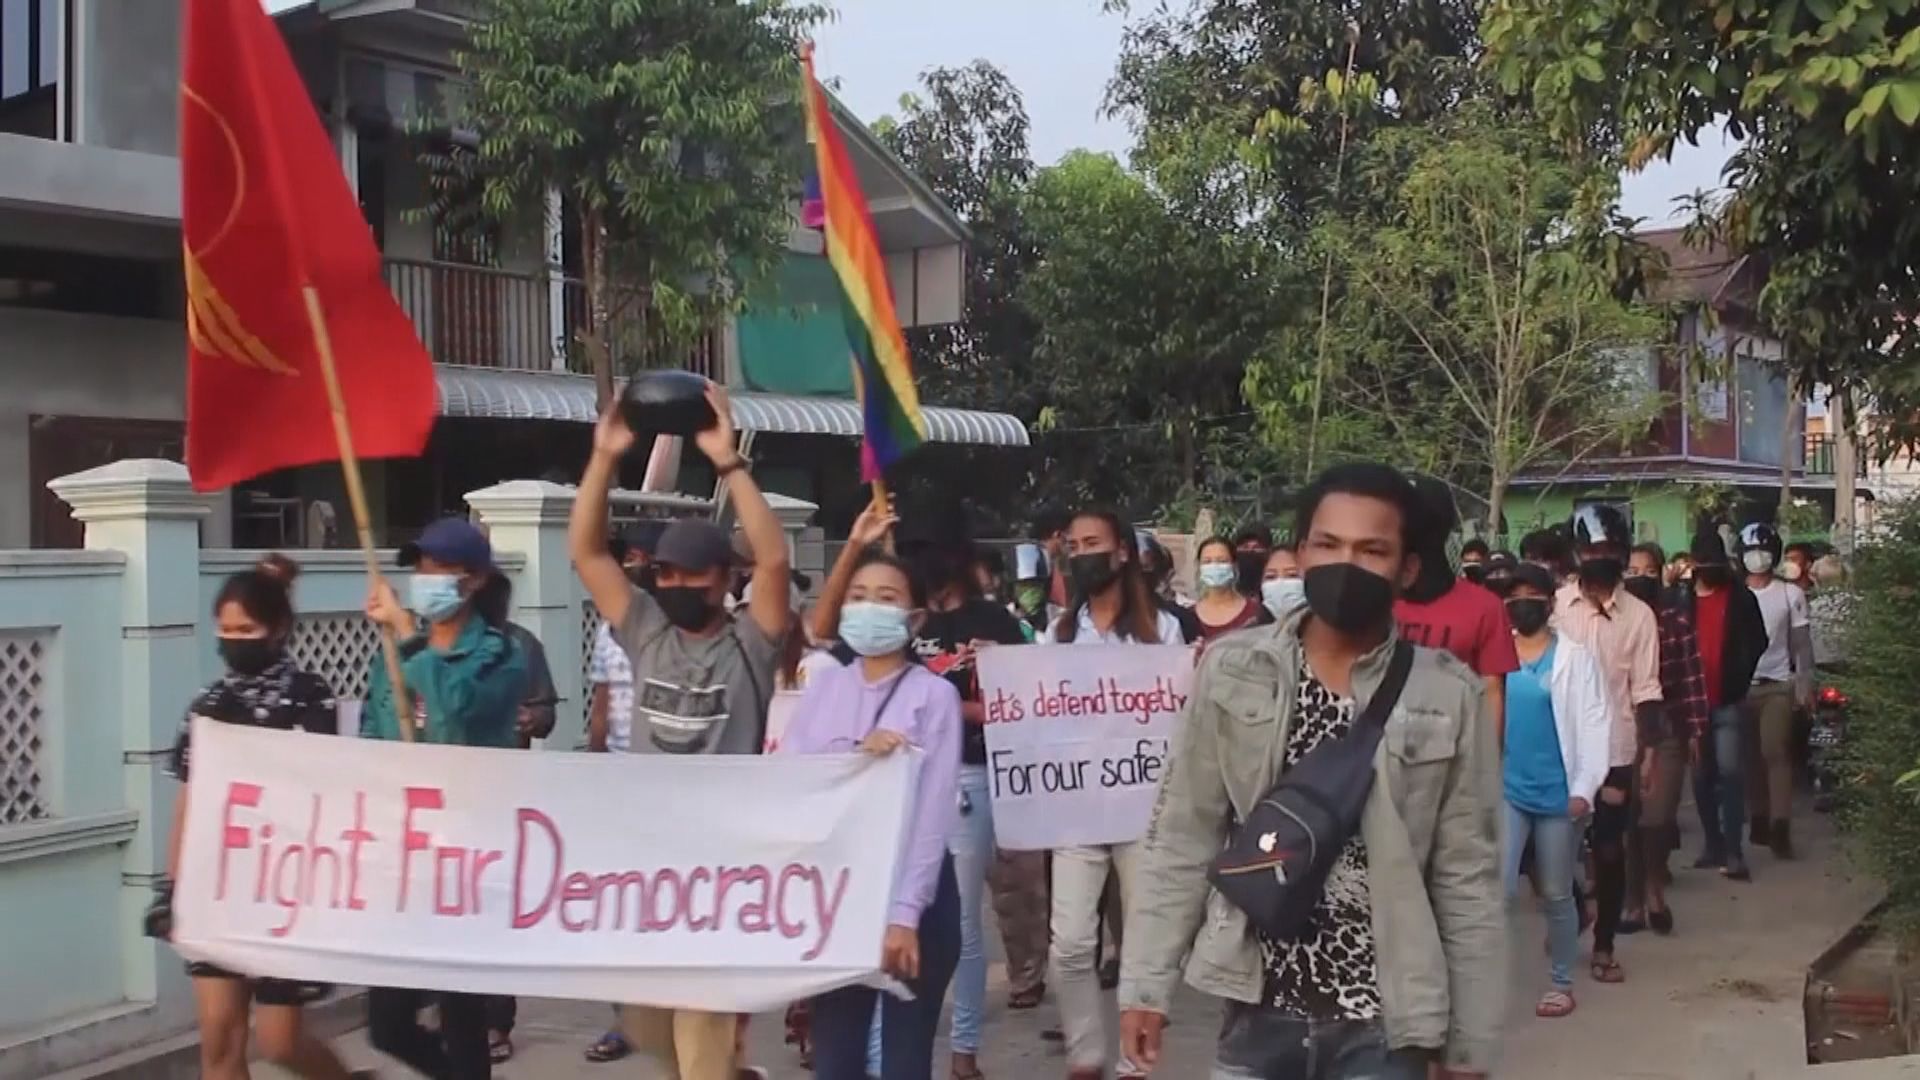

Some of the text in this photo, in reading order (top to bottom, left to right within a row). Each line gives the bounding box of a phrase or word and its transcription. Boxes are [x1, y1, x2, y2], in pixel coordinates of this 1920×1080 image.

[1033, 677, 1106, 718] defend
[992, 749, 1038, 798] For
[1041, 759, 1091, 793] our
[215, 781, 850, 961] Fight For Democracy
